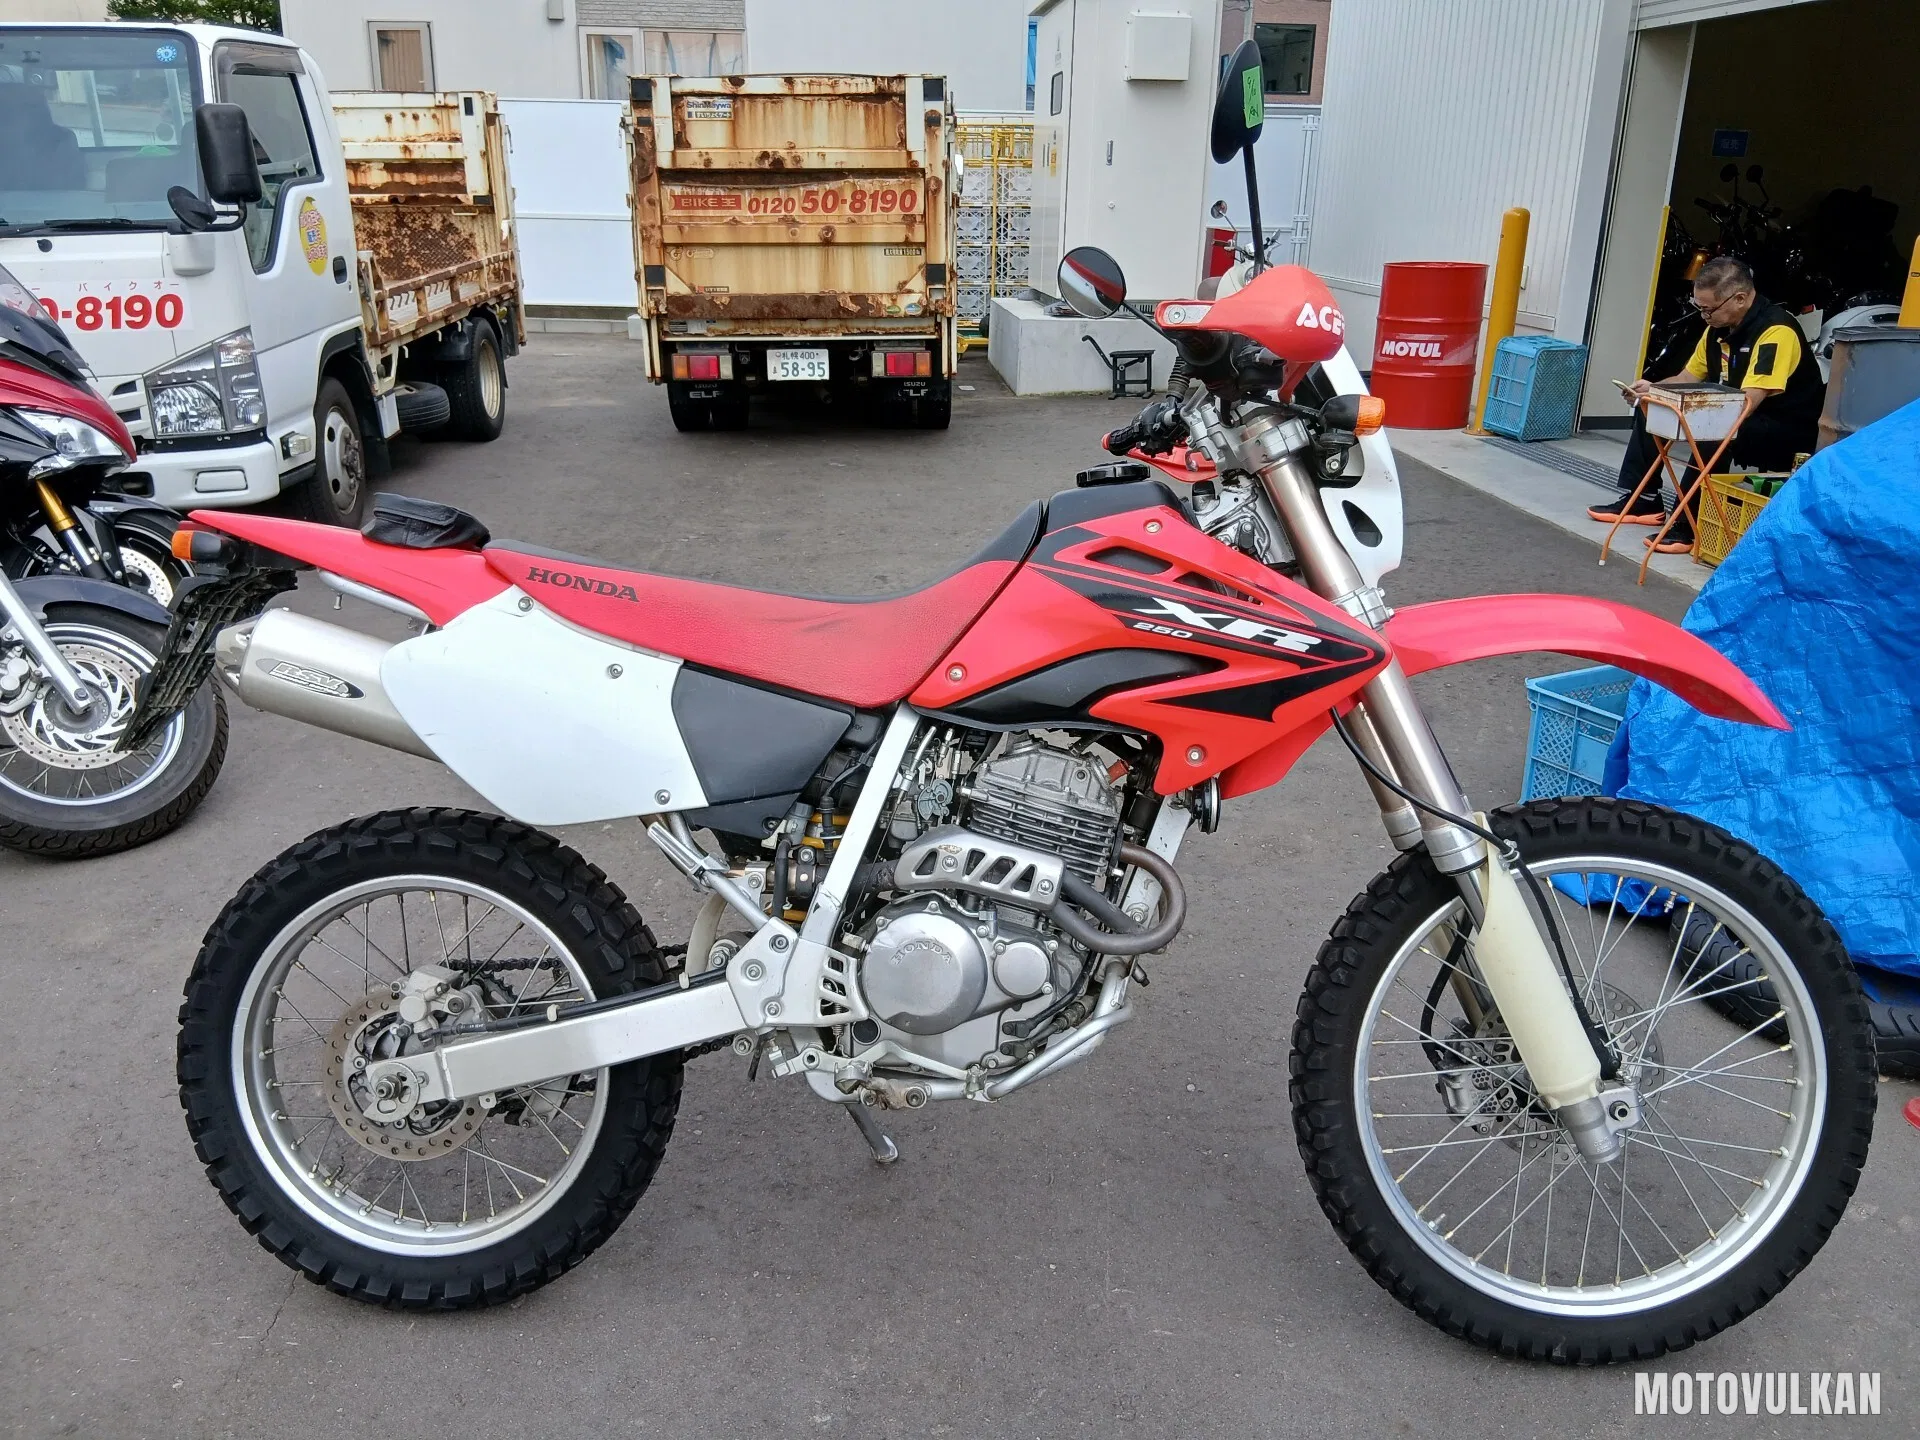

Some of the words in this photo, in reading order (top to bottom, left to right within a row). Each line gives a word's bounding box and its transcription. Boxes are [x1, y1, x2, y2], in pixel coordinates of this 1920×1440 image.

[747, 197, 797, 214] 0120
[801, 189, 918, 214] 50-8190
[5, 294, 184, 331] 0-8190
[800, 351, 815, 360] 400
[1381, 340, 1442, 358] MOTUL
[780, 362, 826, 377] 58-95
[526, 566, 640, 603] HONDA
[1132, 596, 1322, 653] XR
[1132, 621, 1194, 640] 250
[890, 940, 953, 966] HONDA
